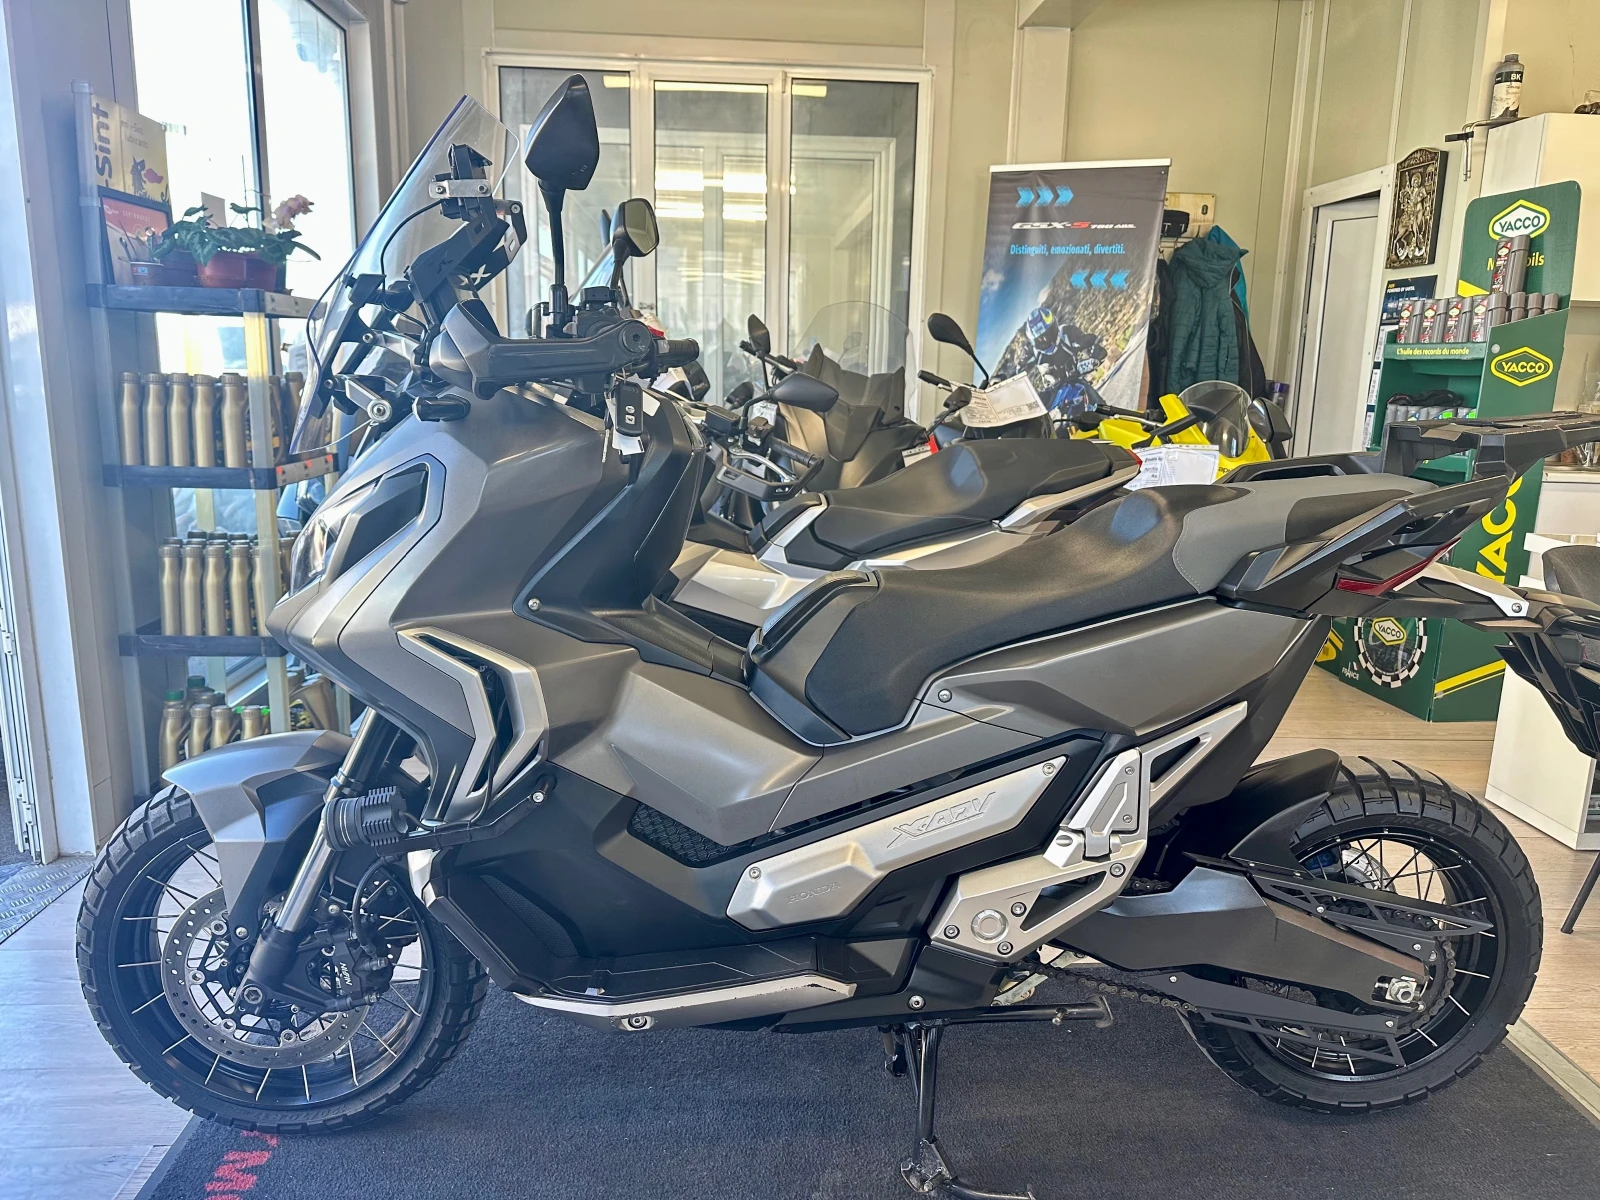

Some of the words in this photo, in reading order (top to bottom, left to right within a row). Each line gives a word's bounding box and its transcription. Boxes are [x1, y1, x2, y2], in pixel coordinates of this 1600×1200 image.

[1510, 73, 1522, 81] BK
[1498, 214, 1541, 233] YACCO
[1010, 243, 1049, 256] Distinguiti,
[1050, 243, 1092, 256] emozionati,
[1093, 243, 1126, 255] divertiti.
[1396, 347, 1413, 355] L'huile
[1413, 347, 1423, 355] des
[1422, 347, 1441, 355] records
[1441, 347, 1450, 355] du
[1450, 346, 1470, 355] monde
[1501, 360, 1545, 374] YACCO
[1377, 623, 1402, 639] YACCO
[1341, 666, 1360, 681] FRANCE
[1380, 816, 1458, 837] PIRELLI
[786, 882, 841, 905] HONDA
